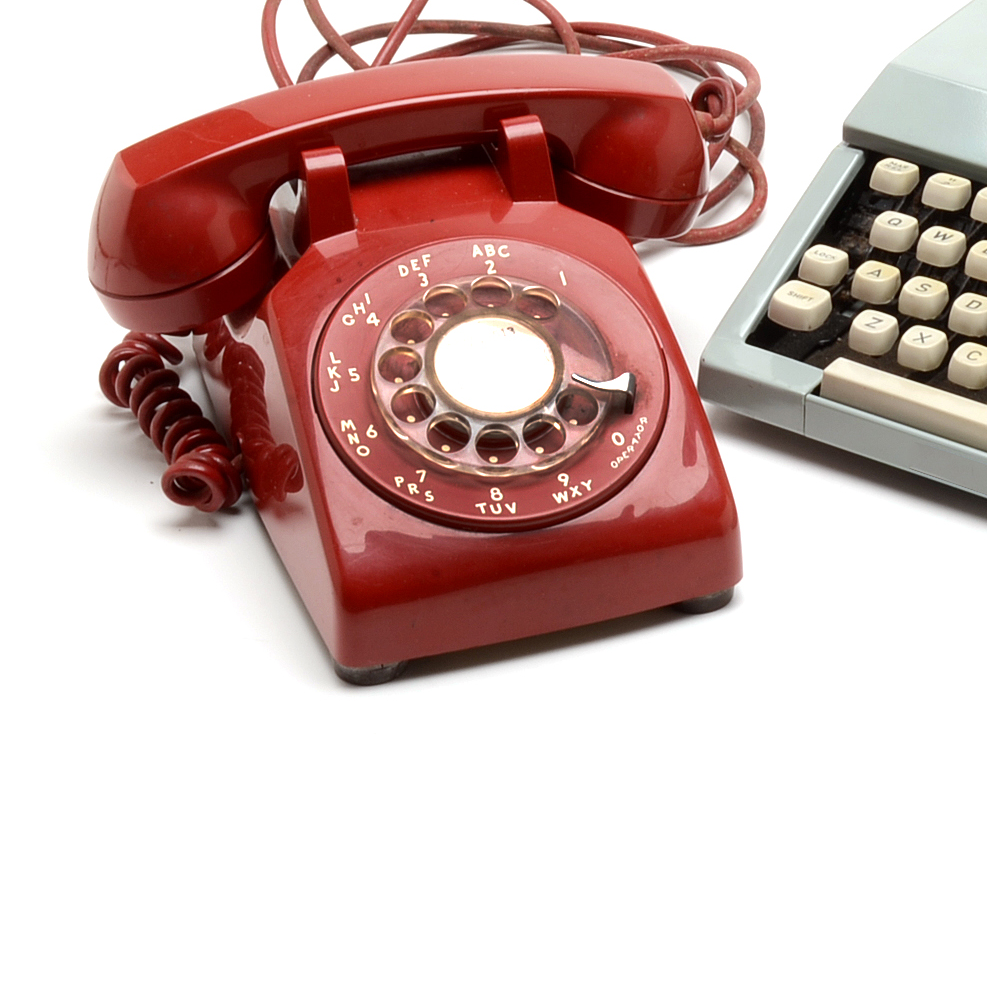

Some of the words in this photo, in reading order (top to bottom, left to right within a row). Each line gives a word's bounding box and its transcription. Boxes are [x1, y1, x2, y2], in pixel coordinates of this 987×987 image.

[887, 217, 903, 227] Q
[933, 230, 954, 242] W
[473, 244, 510, 257] ABC
[398, 254, 431, 277] DEF
[484, 259, 497, 275] 2
[866, 268, 882, 278] A
[417, 272, 429, 287] 3
[559, 270, 567, 287] 1
[915, 283, 932, 292] S
[787, 290, 814, 302] SHIFT
[965, 299, 982, 310] D
[365, 312, 381, 327] 4
[864, 316, 884, 329] Z
[912, 332, 932, 344] X
[966, 350, 983, 361] C
[347, 367, 360, 382] 5
[340, 419, 370, 457] MNO
[365, 424, 378, 439] 6
[611, 431, 625, 446] 0
[610, 416, 648, 469] OPERATOR
[415, 470, 427, 483] 7
[557, 472, 570, 487] 9
[394, 475, 434, 503] PRS
[489, 487, 504, 502] 8
[552, 479, 593, 504] WXY
[475, 501, 517, 515] TUV
